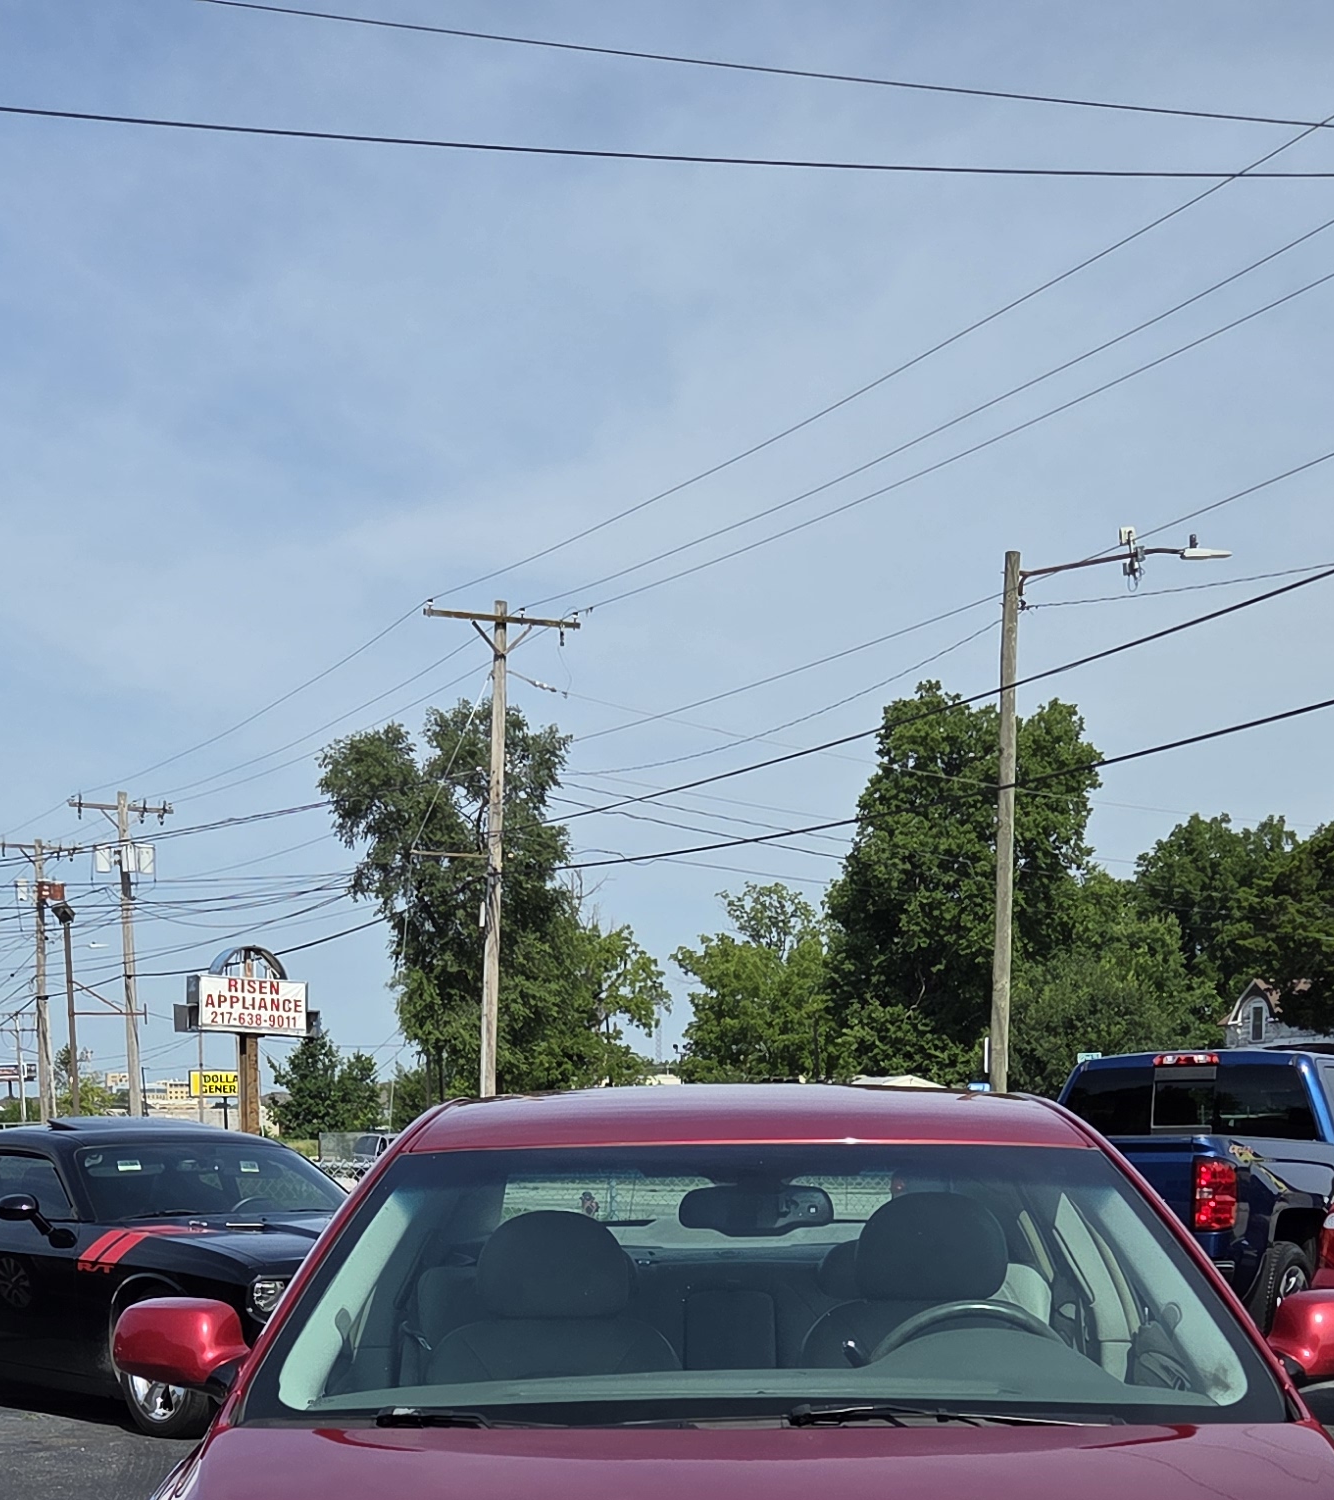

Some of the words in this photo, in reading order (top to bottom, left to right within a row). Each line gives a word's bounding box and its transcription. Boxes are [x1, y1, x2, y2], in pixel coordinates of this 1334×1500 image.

[228, 979, 280, 996] RISEN
[205, 994, 303, 1013] APPLIANCE
[211, 1011, 297, 1028] 217-638-9011
[203, 1074, 238, 1083] DOLLA
